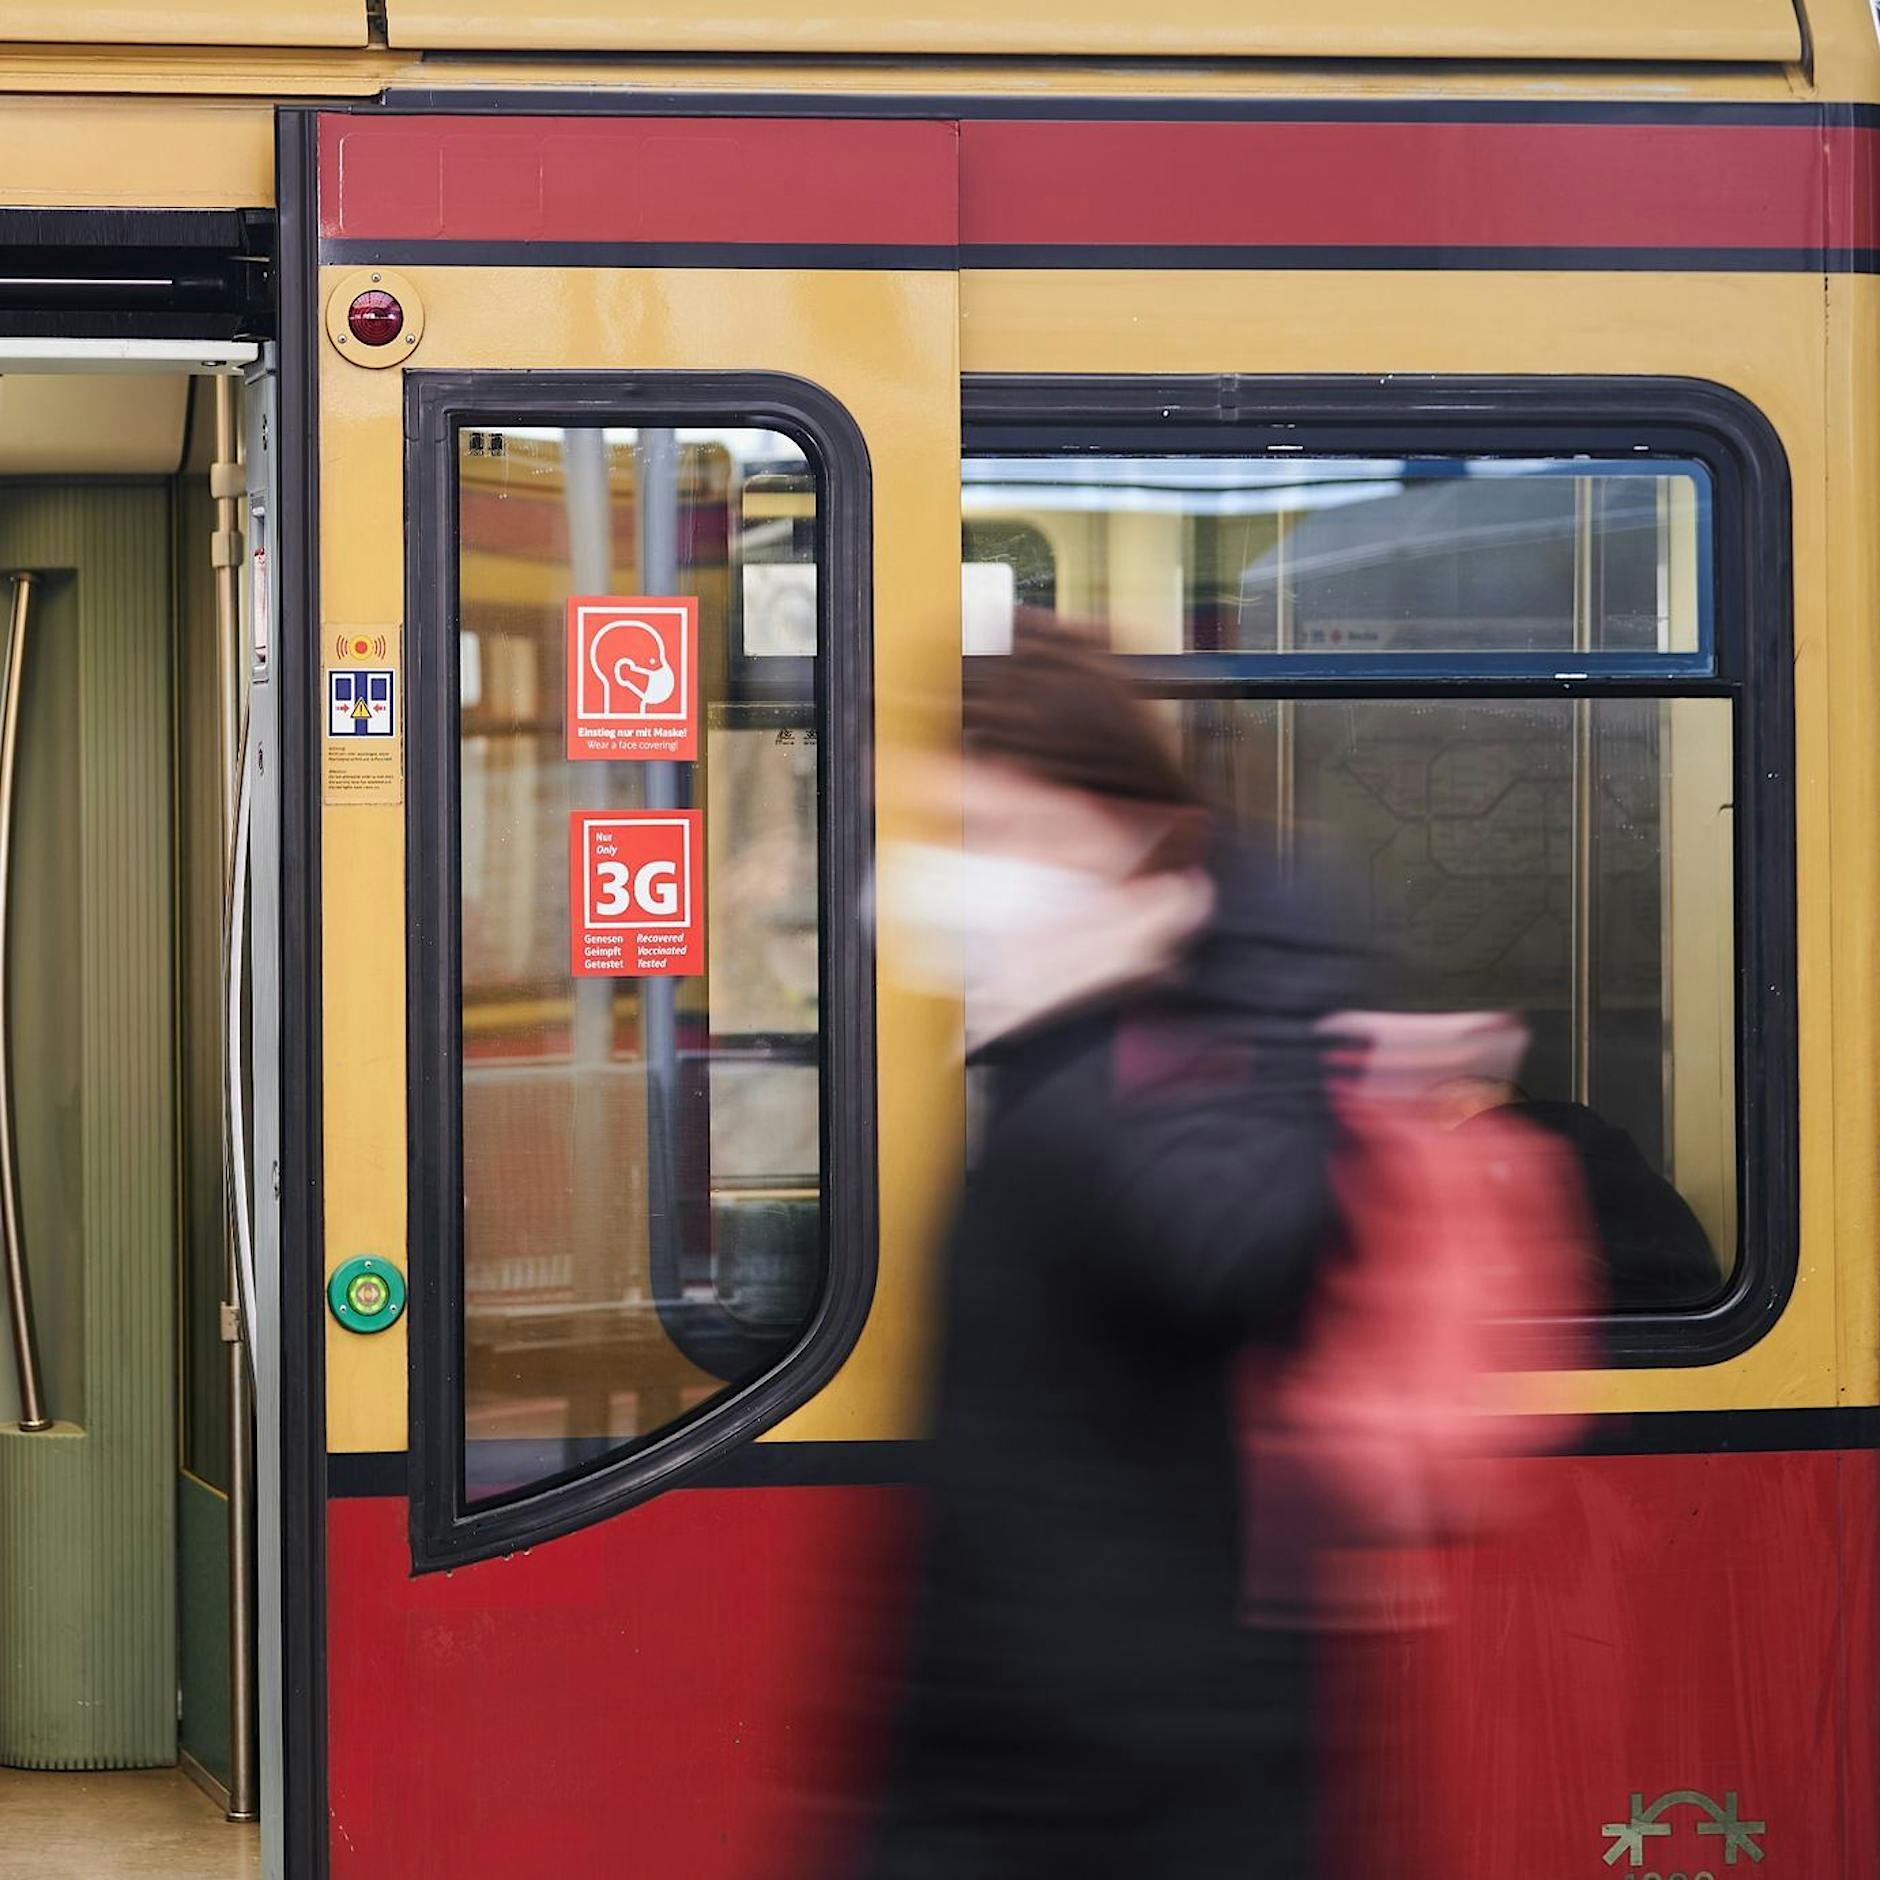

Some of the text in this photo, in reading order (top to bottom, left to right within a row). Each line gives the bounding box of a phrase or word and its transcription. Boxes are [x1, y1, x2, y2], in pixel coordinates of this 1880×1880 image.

[577, 727, 687, 739] Einstieg nur mit Maske!
[587, 740, 679, 752] Wear a face covering!
[595, 832, 613, 842] Nur
[596, 845, 618, 857] Only
[596, 860, 678, 916] 3G
[584, 934, 624, 944] Genesen
[636, 933, 685, 944] Recovered
[584, 946, 622, 958] Geimpft
[637, 945, 688, 956] Vaccinated
[584, 959, 624, 969] Getestet
[637, 958, 668, 969] Tested
